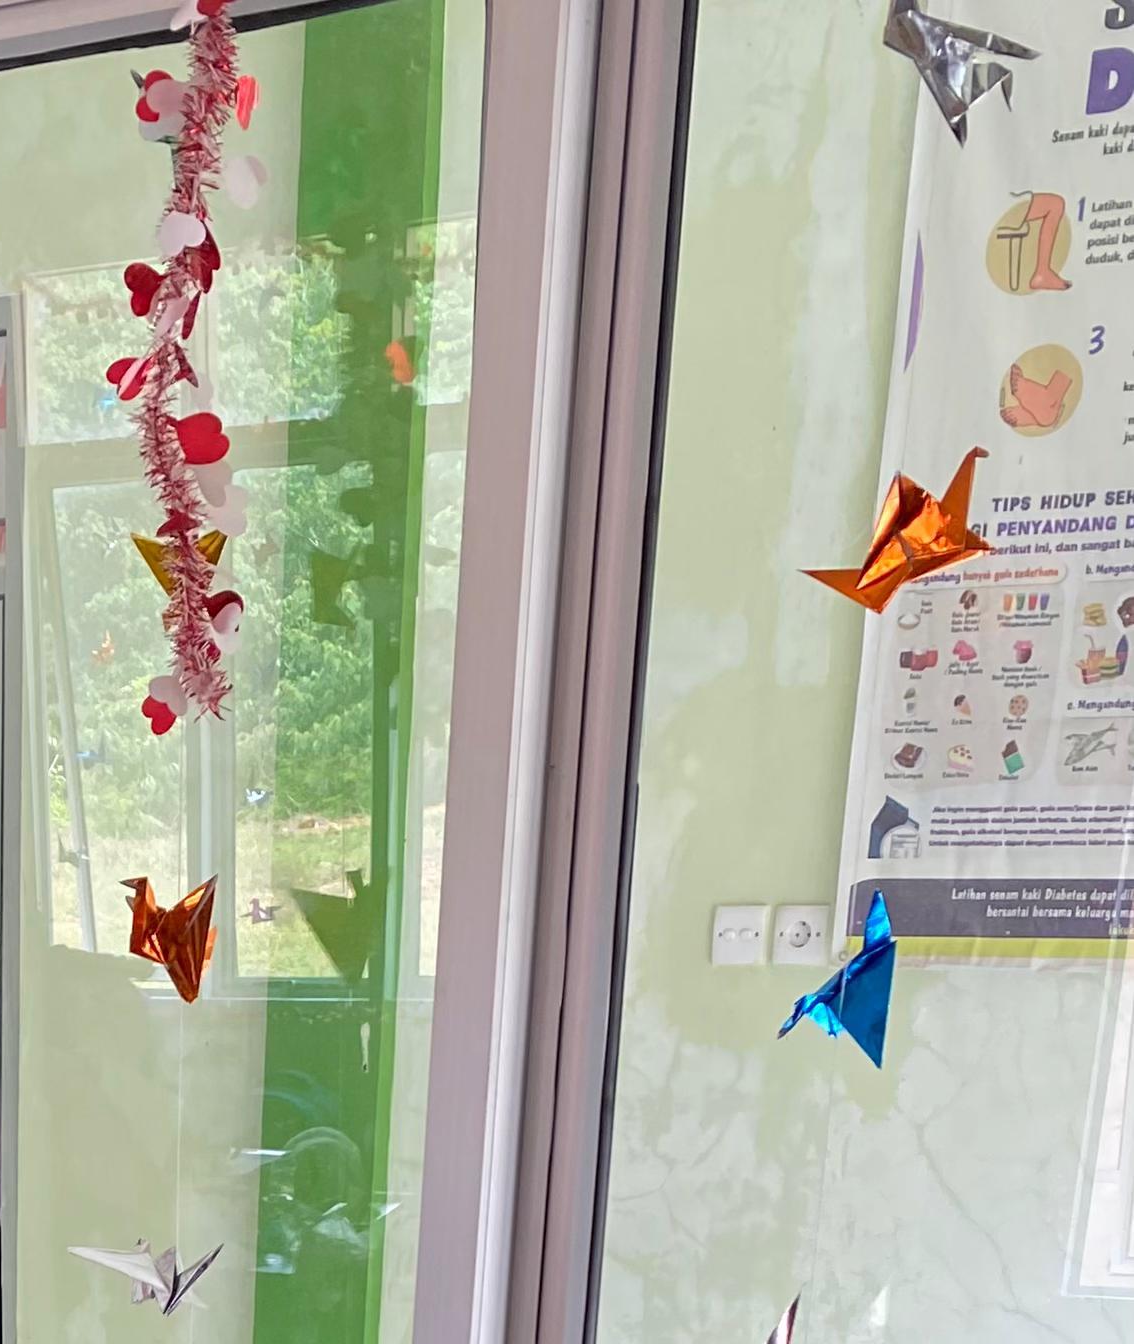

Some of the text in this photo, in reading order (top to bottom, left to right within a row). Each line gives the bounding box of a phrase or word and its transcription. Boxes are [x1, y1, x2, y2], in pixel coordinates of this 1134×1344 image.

[1088, 124, 1108, 138] kaki
[1103, 143, 1123, 155] kaki
[1078, 196, 1133, 222] 1 Latihan
[1089, 217, 1121, 231] dapat
[1087, 234, 1119, 250] posisi
[1085, 251, 1123, 265] duduk,
[1088, 325, 1105, 355] 3
[992, 496, 1031, 513] TIPS
[1040, 493, 1096, 510] HIDUP
[996, 515, 1117, 538] PENYANDANG
[1056, 541, 1078, 552] dan
[1081, 538, 1120, 552] sangat
[951, 888, 986, 901] Latihan
[990, 890, 1019, 901] senam
[1022, 888, 1042, 901] kaki
[1045, 888, 1087, 901] Diabetes
[986, 905, 1030, 918] bersantai
[1033, 905, 1072, 918] bersama
